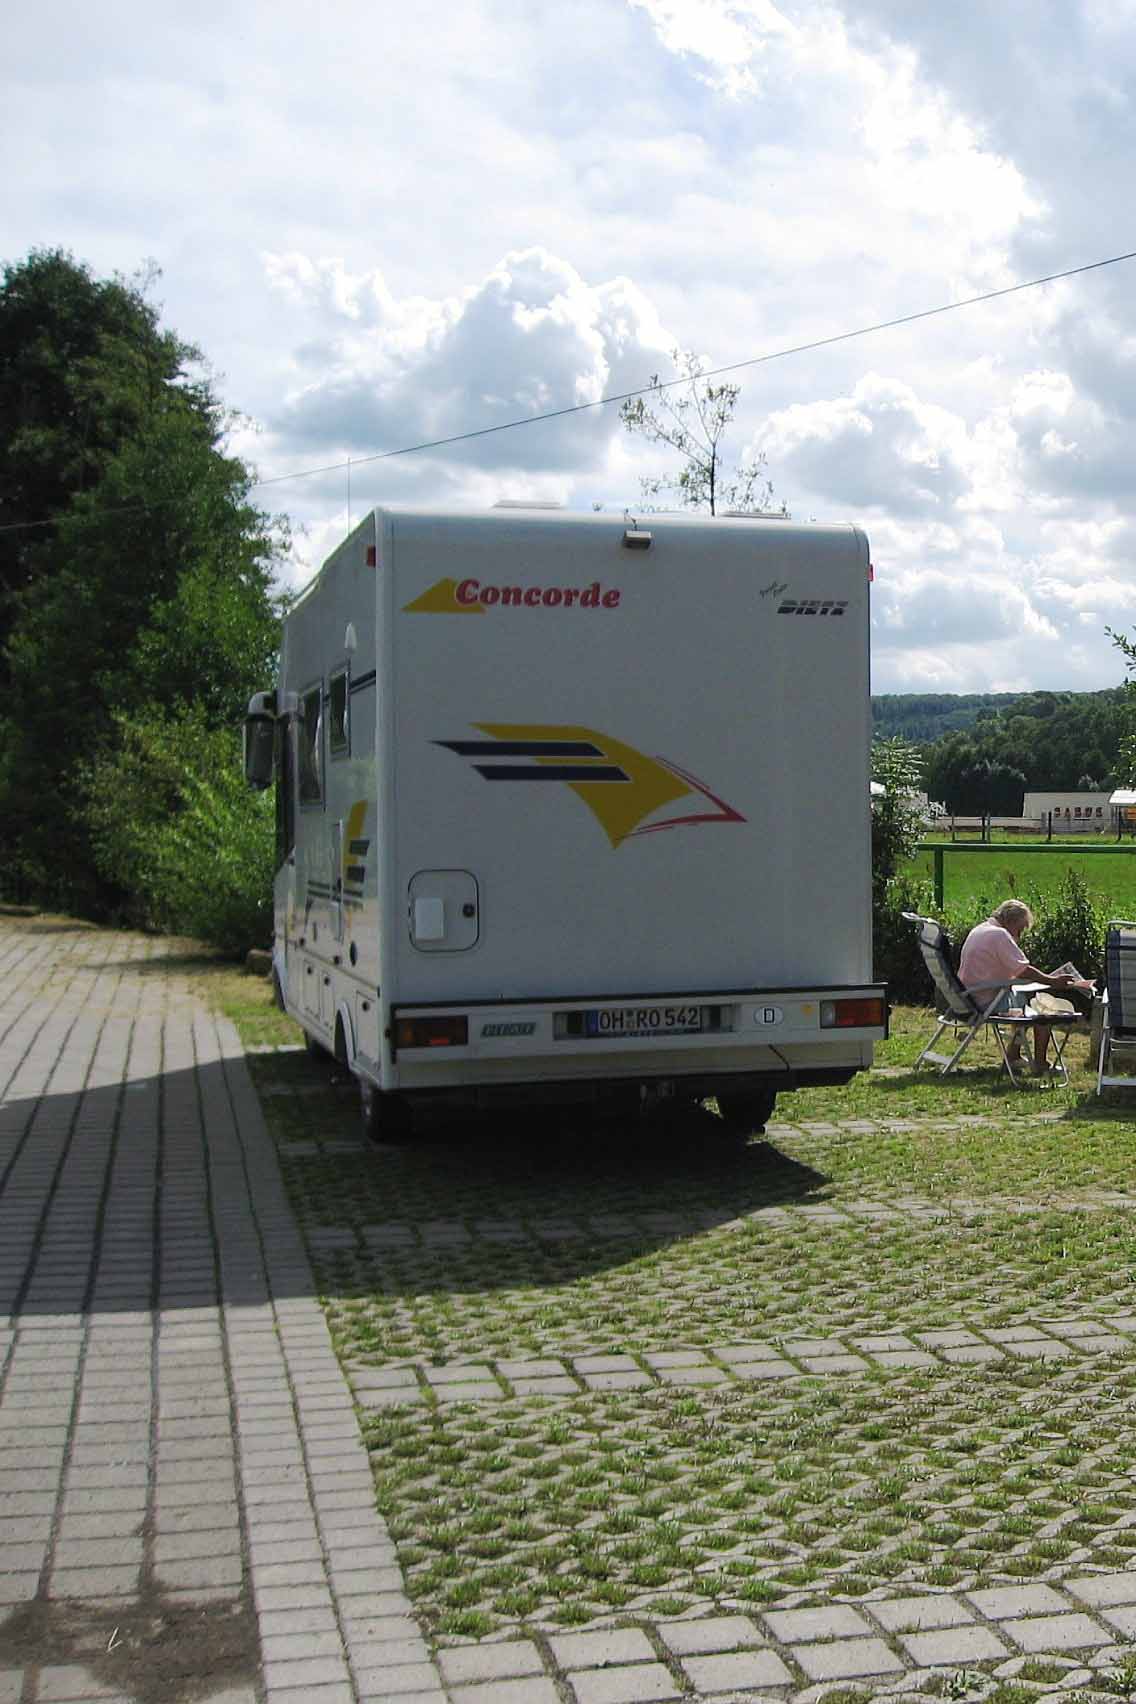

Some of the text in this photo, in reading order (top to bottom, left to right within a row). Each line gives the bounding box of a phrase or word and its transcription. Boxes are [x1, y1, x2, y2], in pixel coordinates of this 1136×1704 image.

[455, 579, 621, 607] Concorde
[600, 1007, 698, 1029] OH RO 542
[764, 1008, 774, 1023] D
